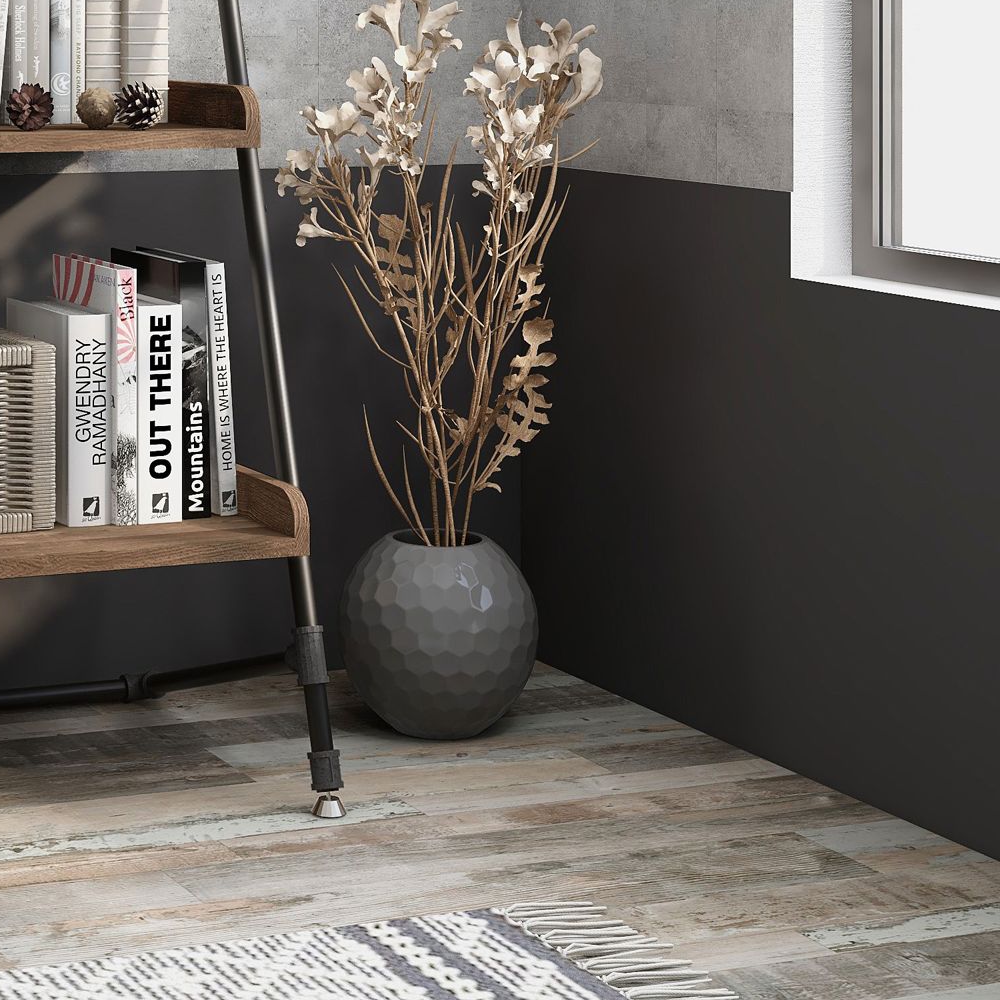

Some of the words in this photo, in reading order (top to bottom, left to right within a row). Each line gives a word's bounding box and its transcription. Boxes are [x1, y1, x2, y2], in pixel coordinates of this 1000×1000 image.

[14, 4, 26, 34] Sherlock
[15, 34, 26, 62] Holmes
[118, 276, 134, 322] Black
[212, 273, 222, 288] IS
[213, 290, 224, 335] HEART
[149, 314, 172, 412] THERE
[216, 336, 226, 361] THE
[75, 339, 92, 443] GWENDRY
[92, 338, 107, 465] RAMADHANY
[217, 364, 230, 412] WHERE
[220, 415, 230, 430] IS
[149, 420, 172, 480] OUT
[186, 401, 205, 512] Mountains
[221, 431, 233, 472] HOME
